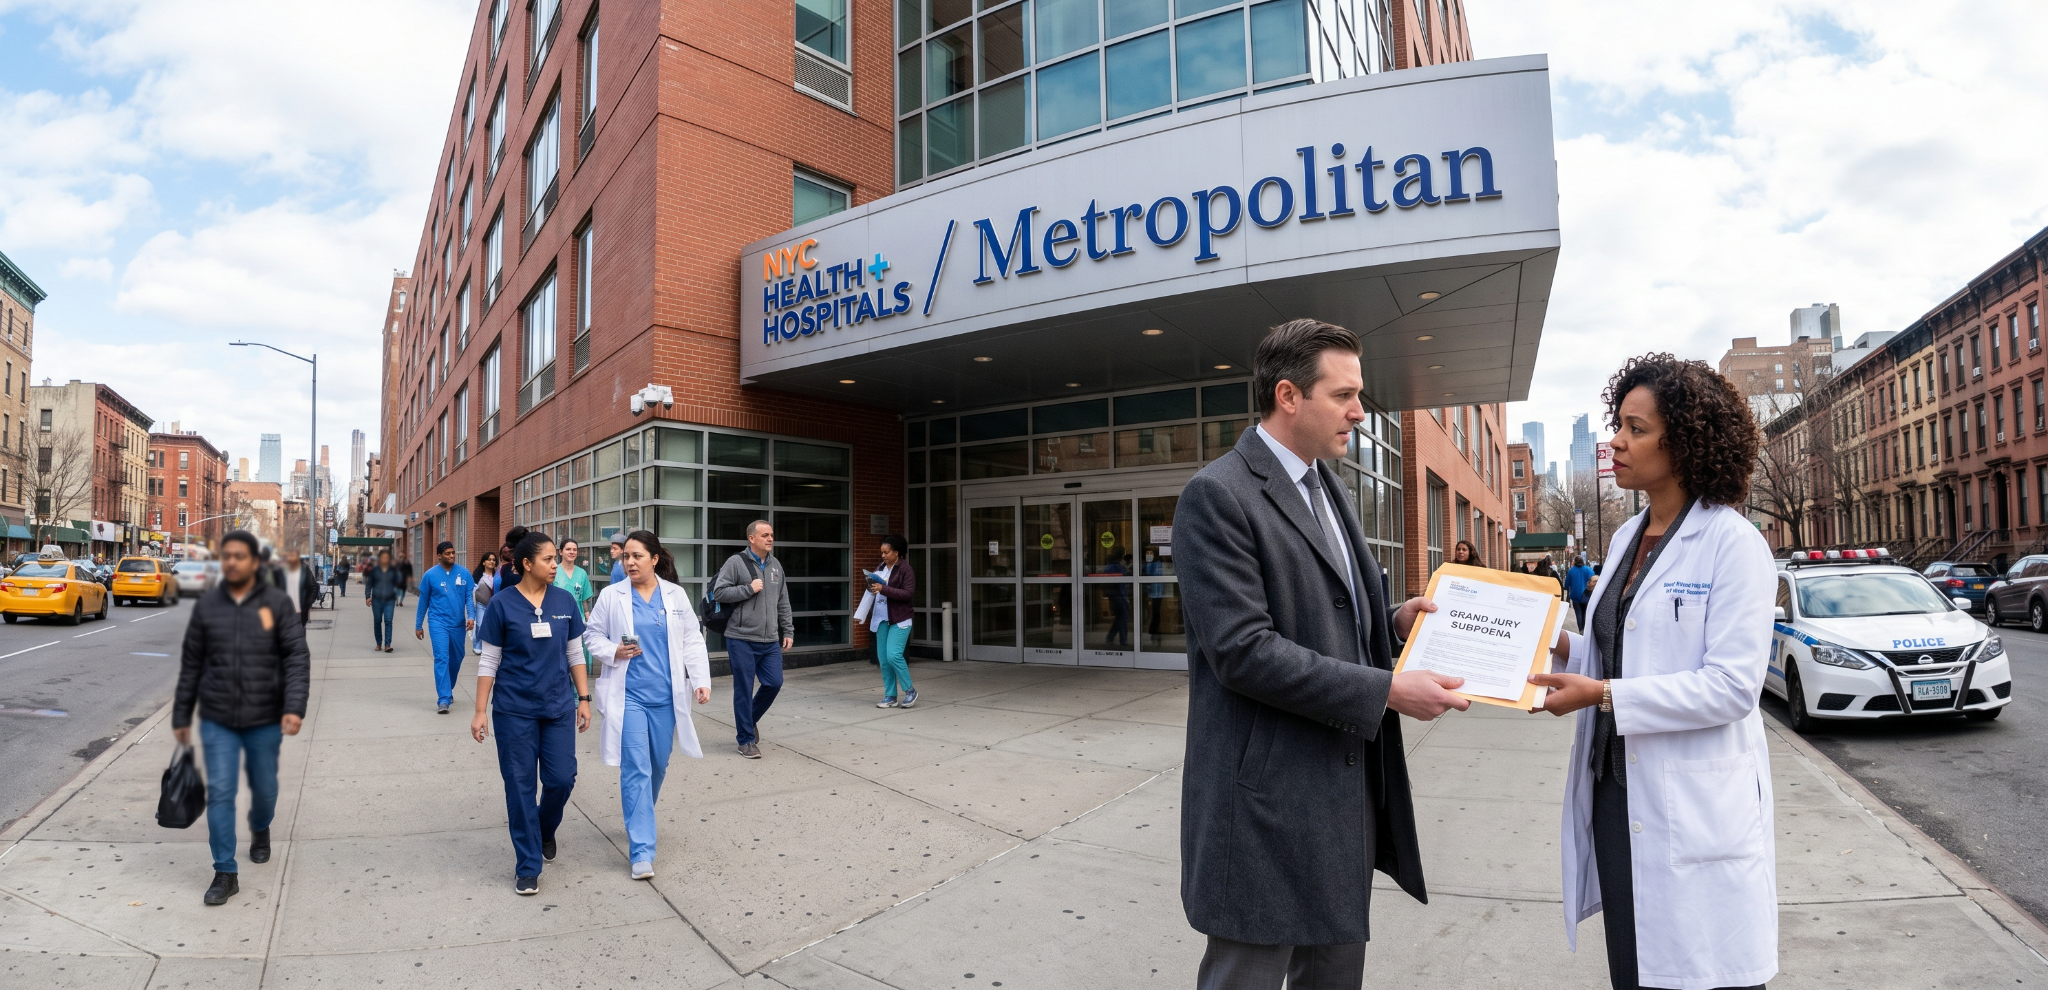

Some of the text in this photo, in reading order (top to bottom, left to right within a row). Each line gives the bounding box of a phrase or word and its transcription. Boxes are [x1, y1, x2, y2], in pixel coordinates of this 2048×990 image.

[972, 142, 1503, 285] Metropolitan
[763, 238, 819, 282] NYC
[763, 281, 913, 346] HOSPITALS
[1449, 609, 1521, 629] GRAND JURY
[1450, 621, 1511, 639] SUBPOENA
[1892, 637, 1946, 649] POLICE
